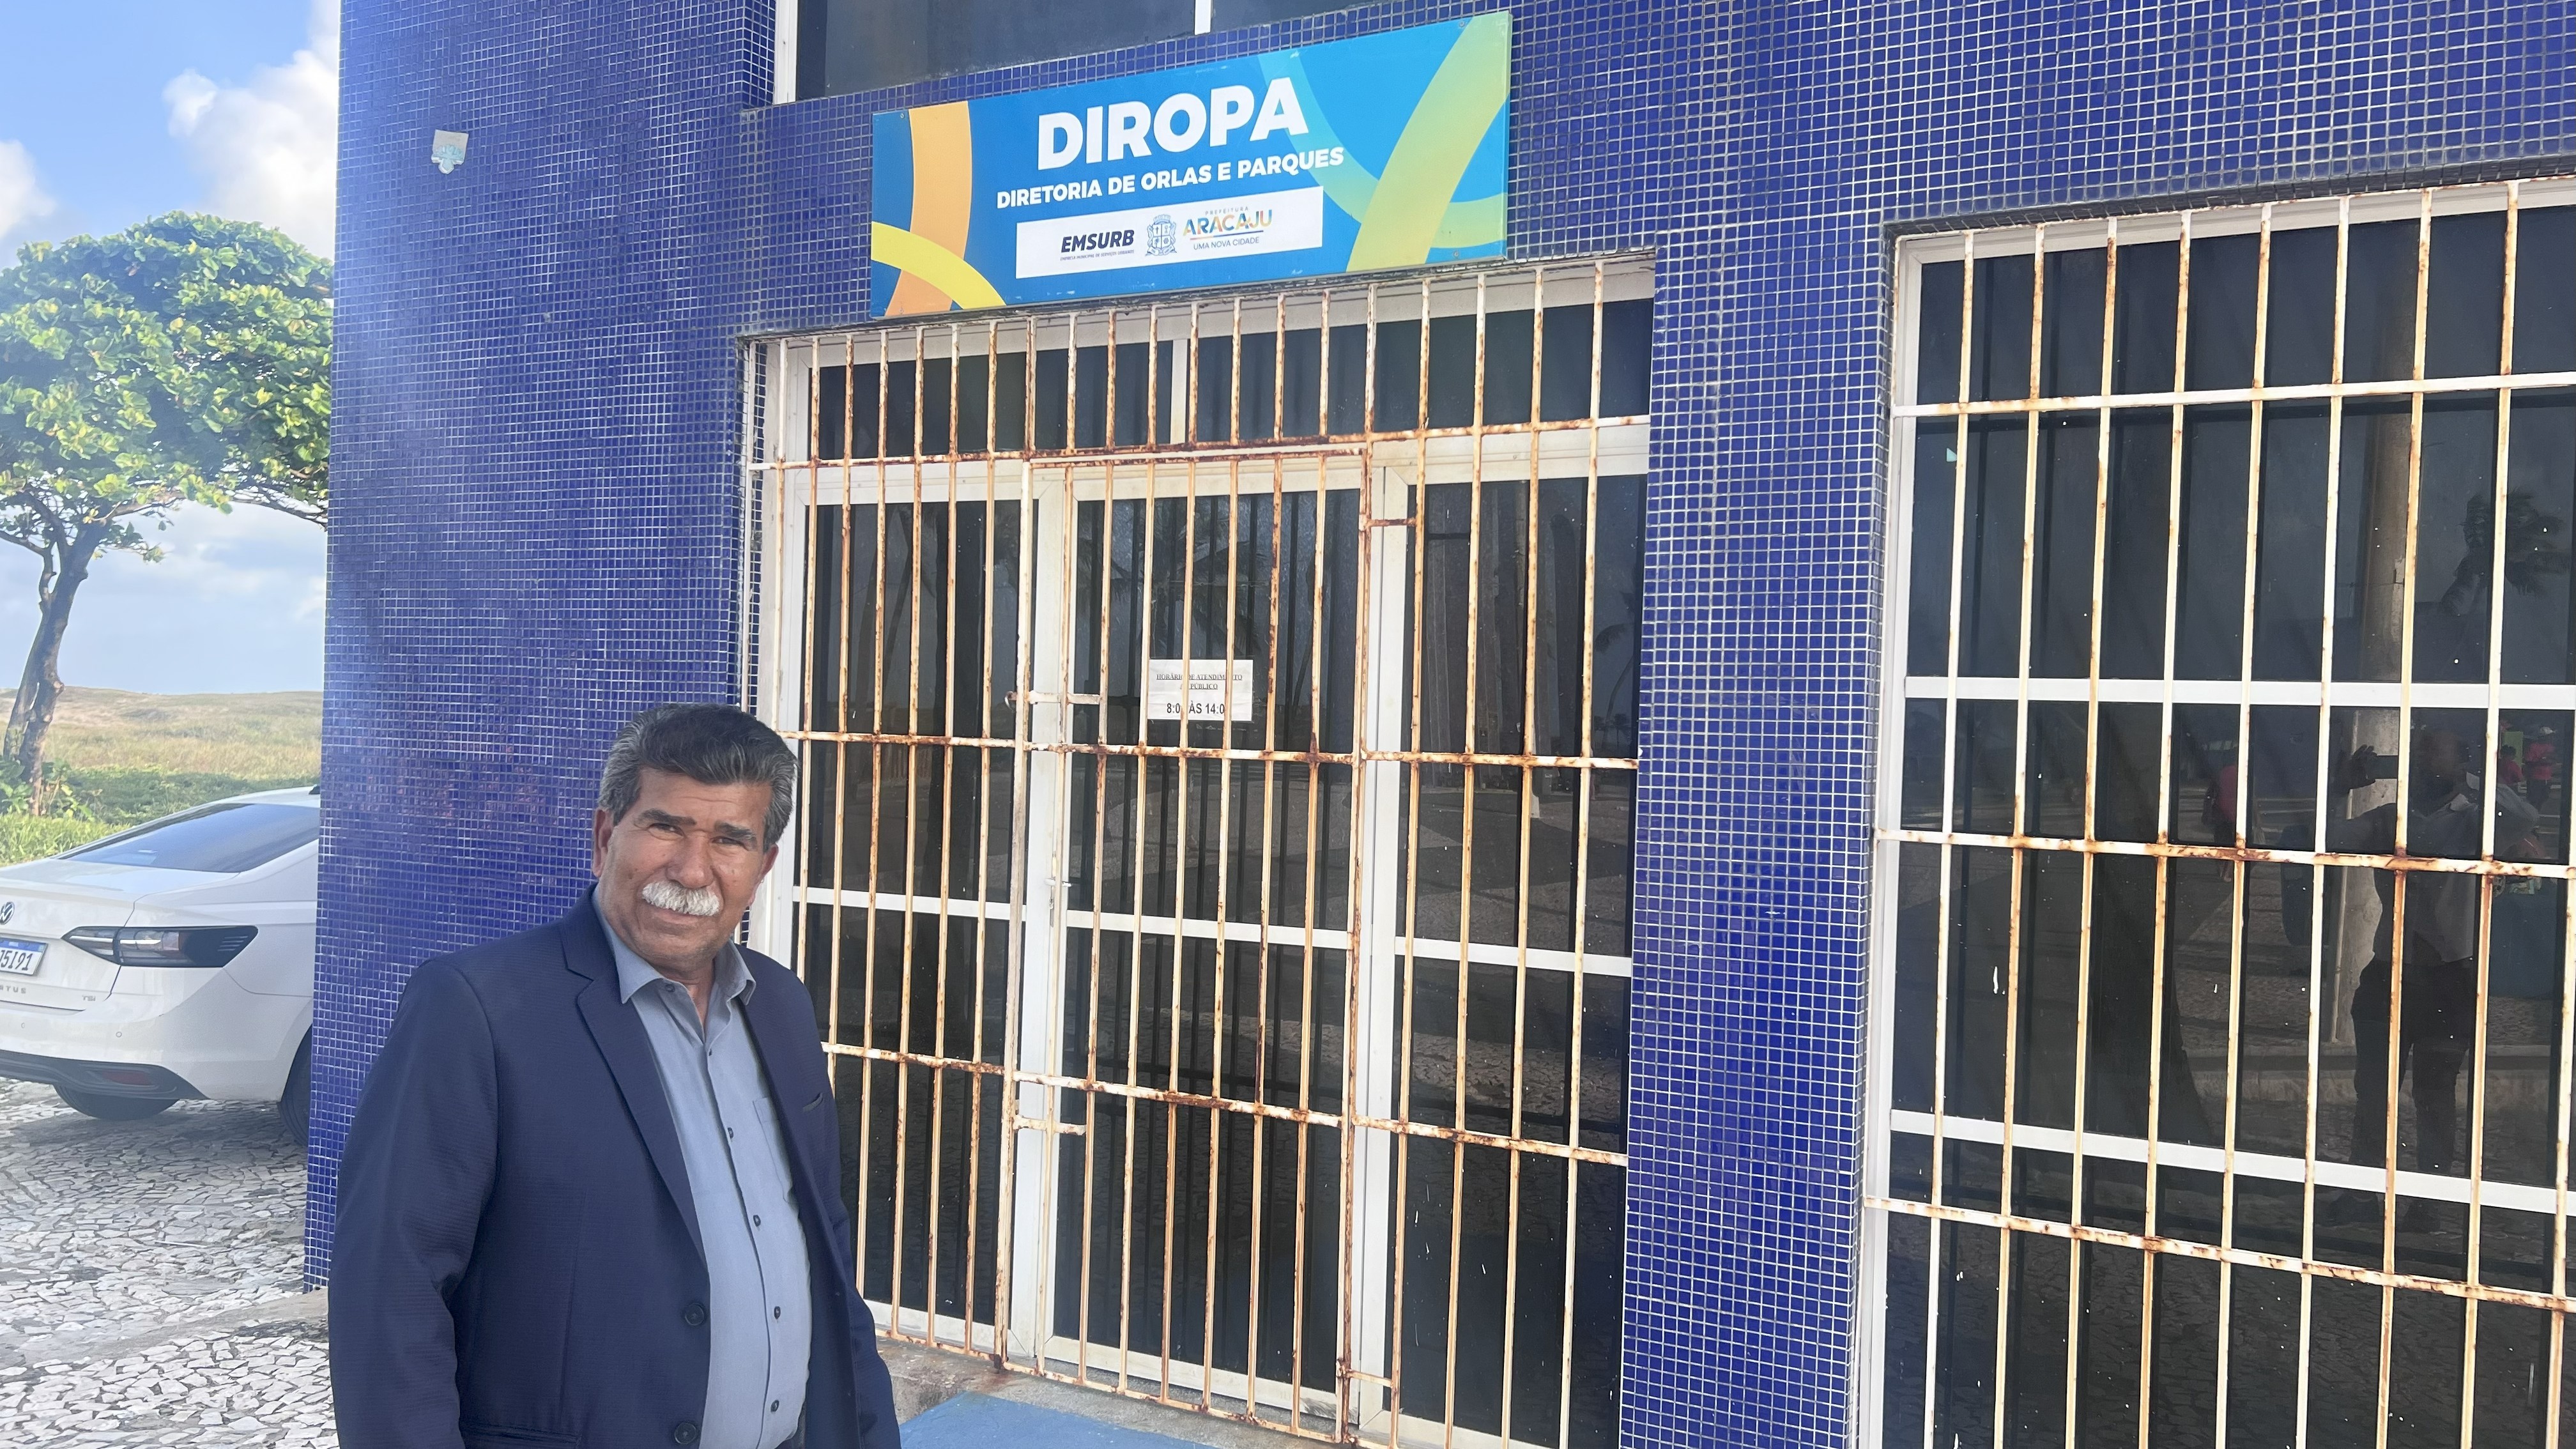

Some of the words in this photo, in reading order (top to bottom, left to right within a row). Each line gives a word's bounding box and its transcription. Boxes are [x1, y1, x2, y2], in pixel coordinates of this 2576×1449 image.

[1038, 77, 1308, 170] DIROPA
[997, 179, 1103, 209] DIRETORIA
[1108, 174, 1135, 195] DE
[1140, 165, 1212, 191] ORLAS
[1217, 162, 1231, 181] E
[1238, 146, 1344, 179] PARQUES
[1183, 209, 1273, 236] ARACAJU
[1205, 206, 1249, 215] PREFEITURA
[1061, 229, 1135, 253] EMSURB
[1193, 242, 1209, 250] UMA
[1211, 240, 1231, 249] NOVA
[1232, 236, 1260, 246] CIDADE
[1167, 703, 1181, 714] 8:0
[1188, 700, 1202, 714] ÀS
[1205, 703, 1226, 714] 14:0
